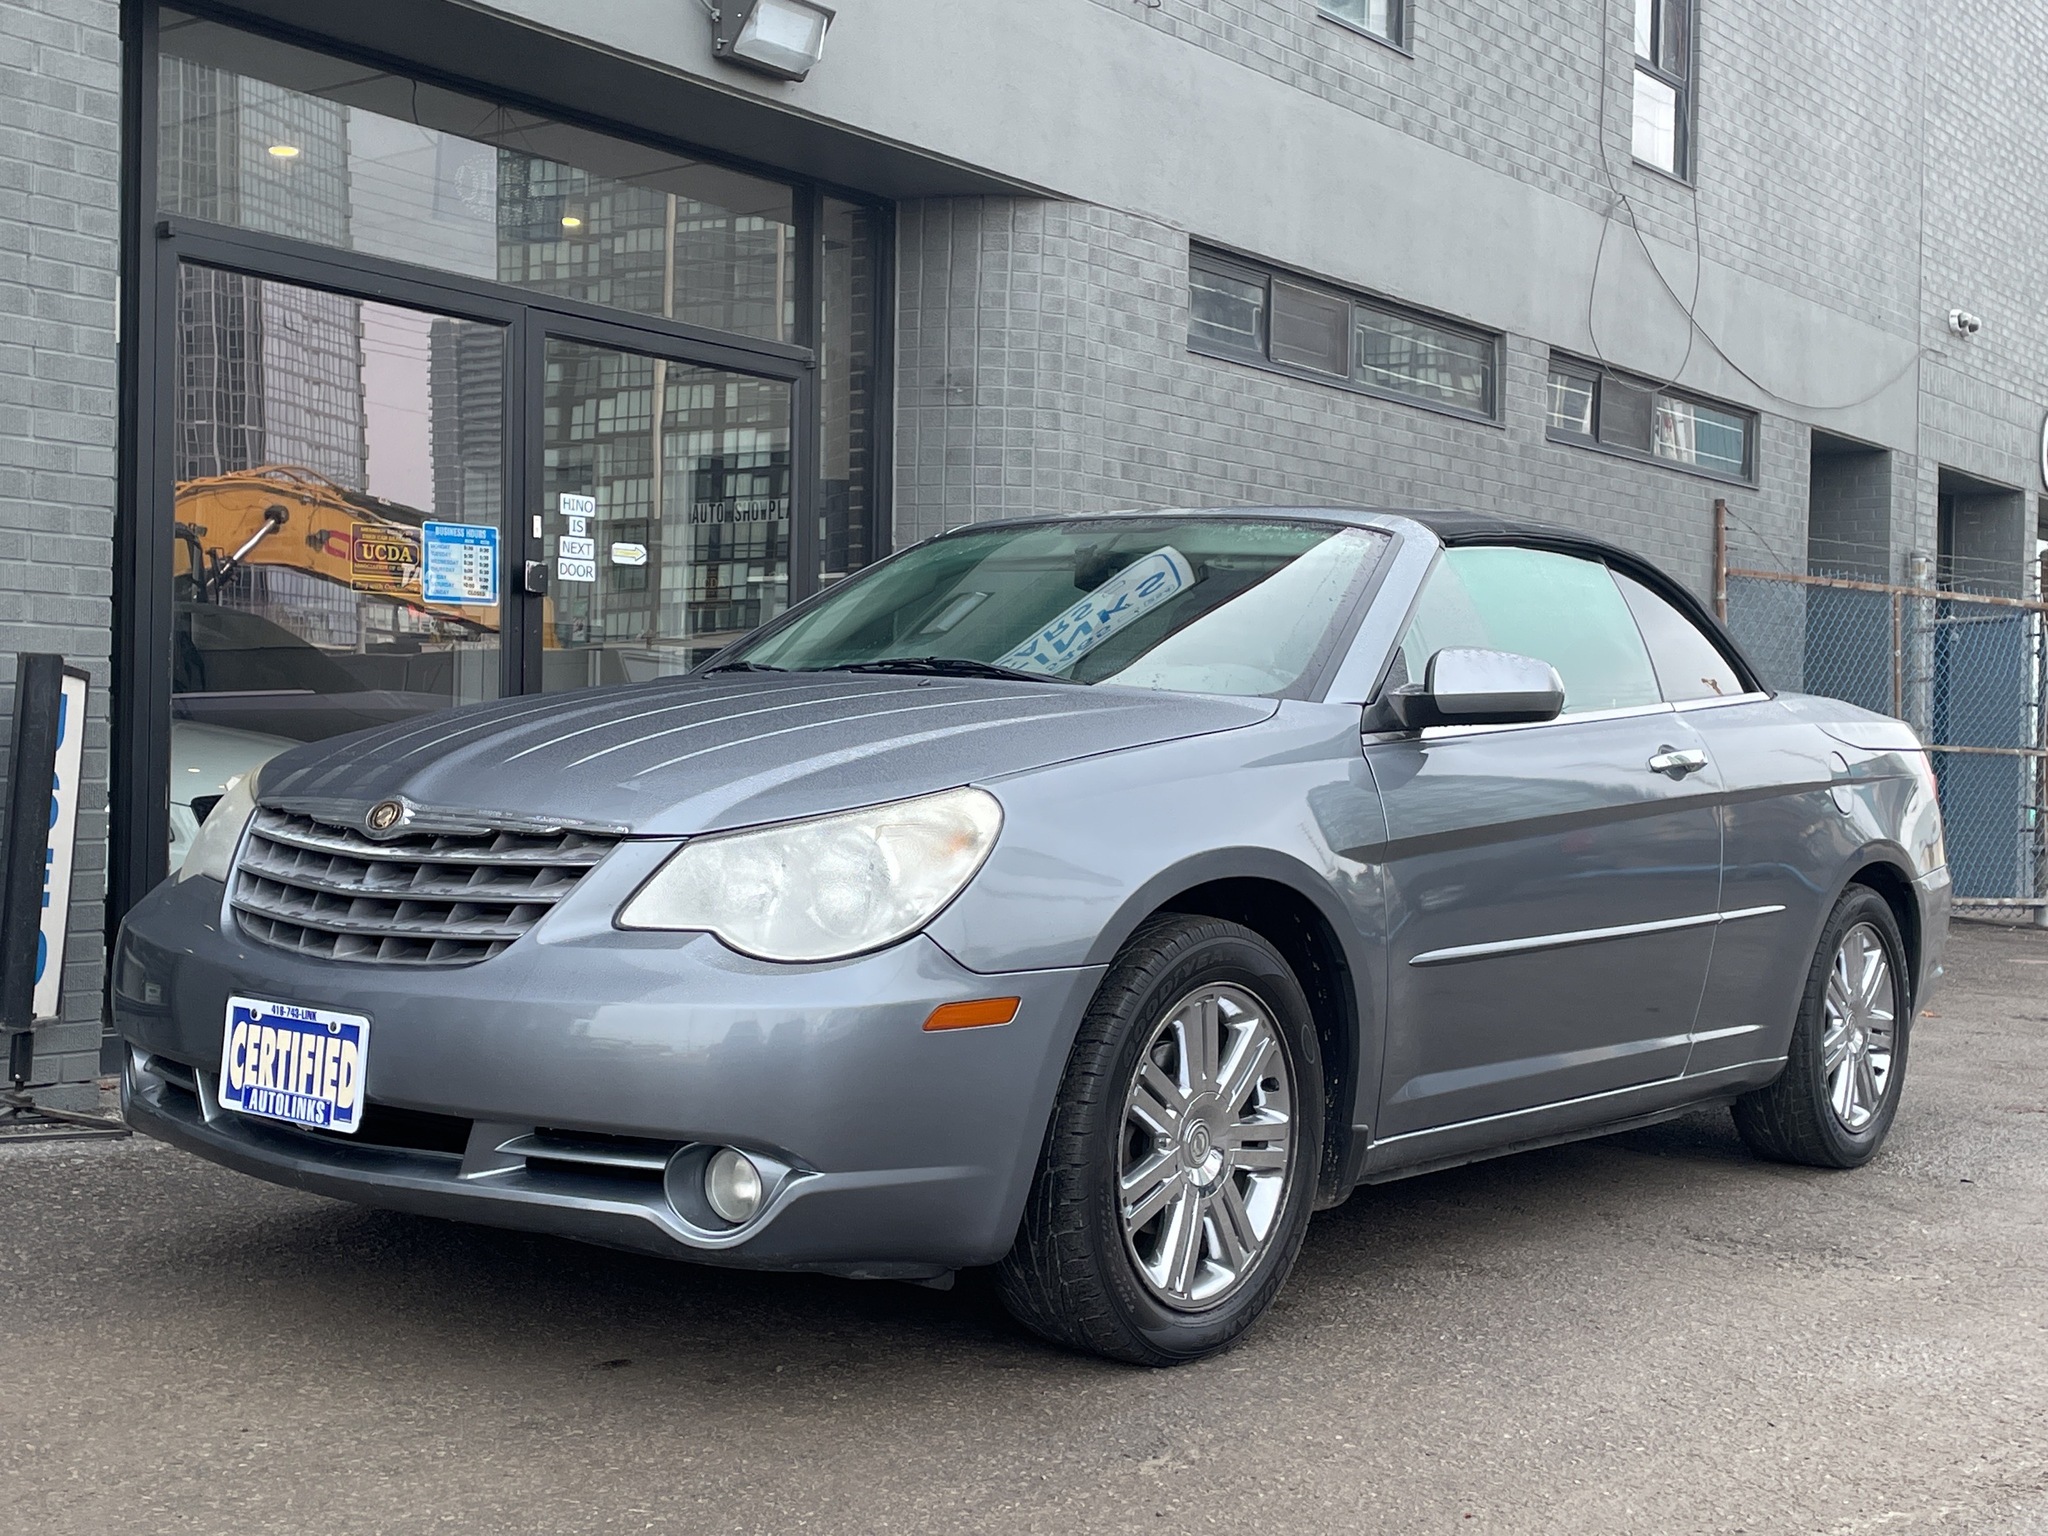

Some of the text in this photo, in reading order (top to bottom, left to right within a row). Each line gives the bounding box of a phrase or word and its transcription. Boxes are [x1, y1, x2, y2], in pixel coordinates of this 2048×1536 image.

[562, 497, 594, 514] HINO
[692, 503, 725, 523] AUTO
[435, 526, 487, 539] BUSINESS HOURS
[572, 520, 584, 533] IS
[362, 543, 413, 563] UCDA
[562, 541, 593, 556] NEXT
[559, 563, 594, 579] DOOR
[467, 589, 486, 597] CLOSED
[230, 1021, 359, 1109] CERTIFIED
[248, 1088, 326, 1124] AUTOLINKS
